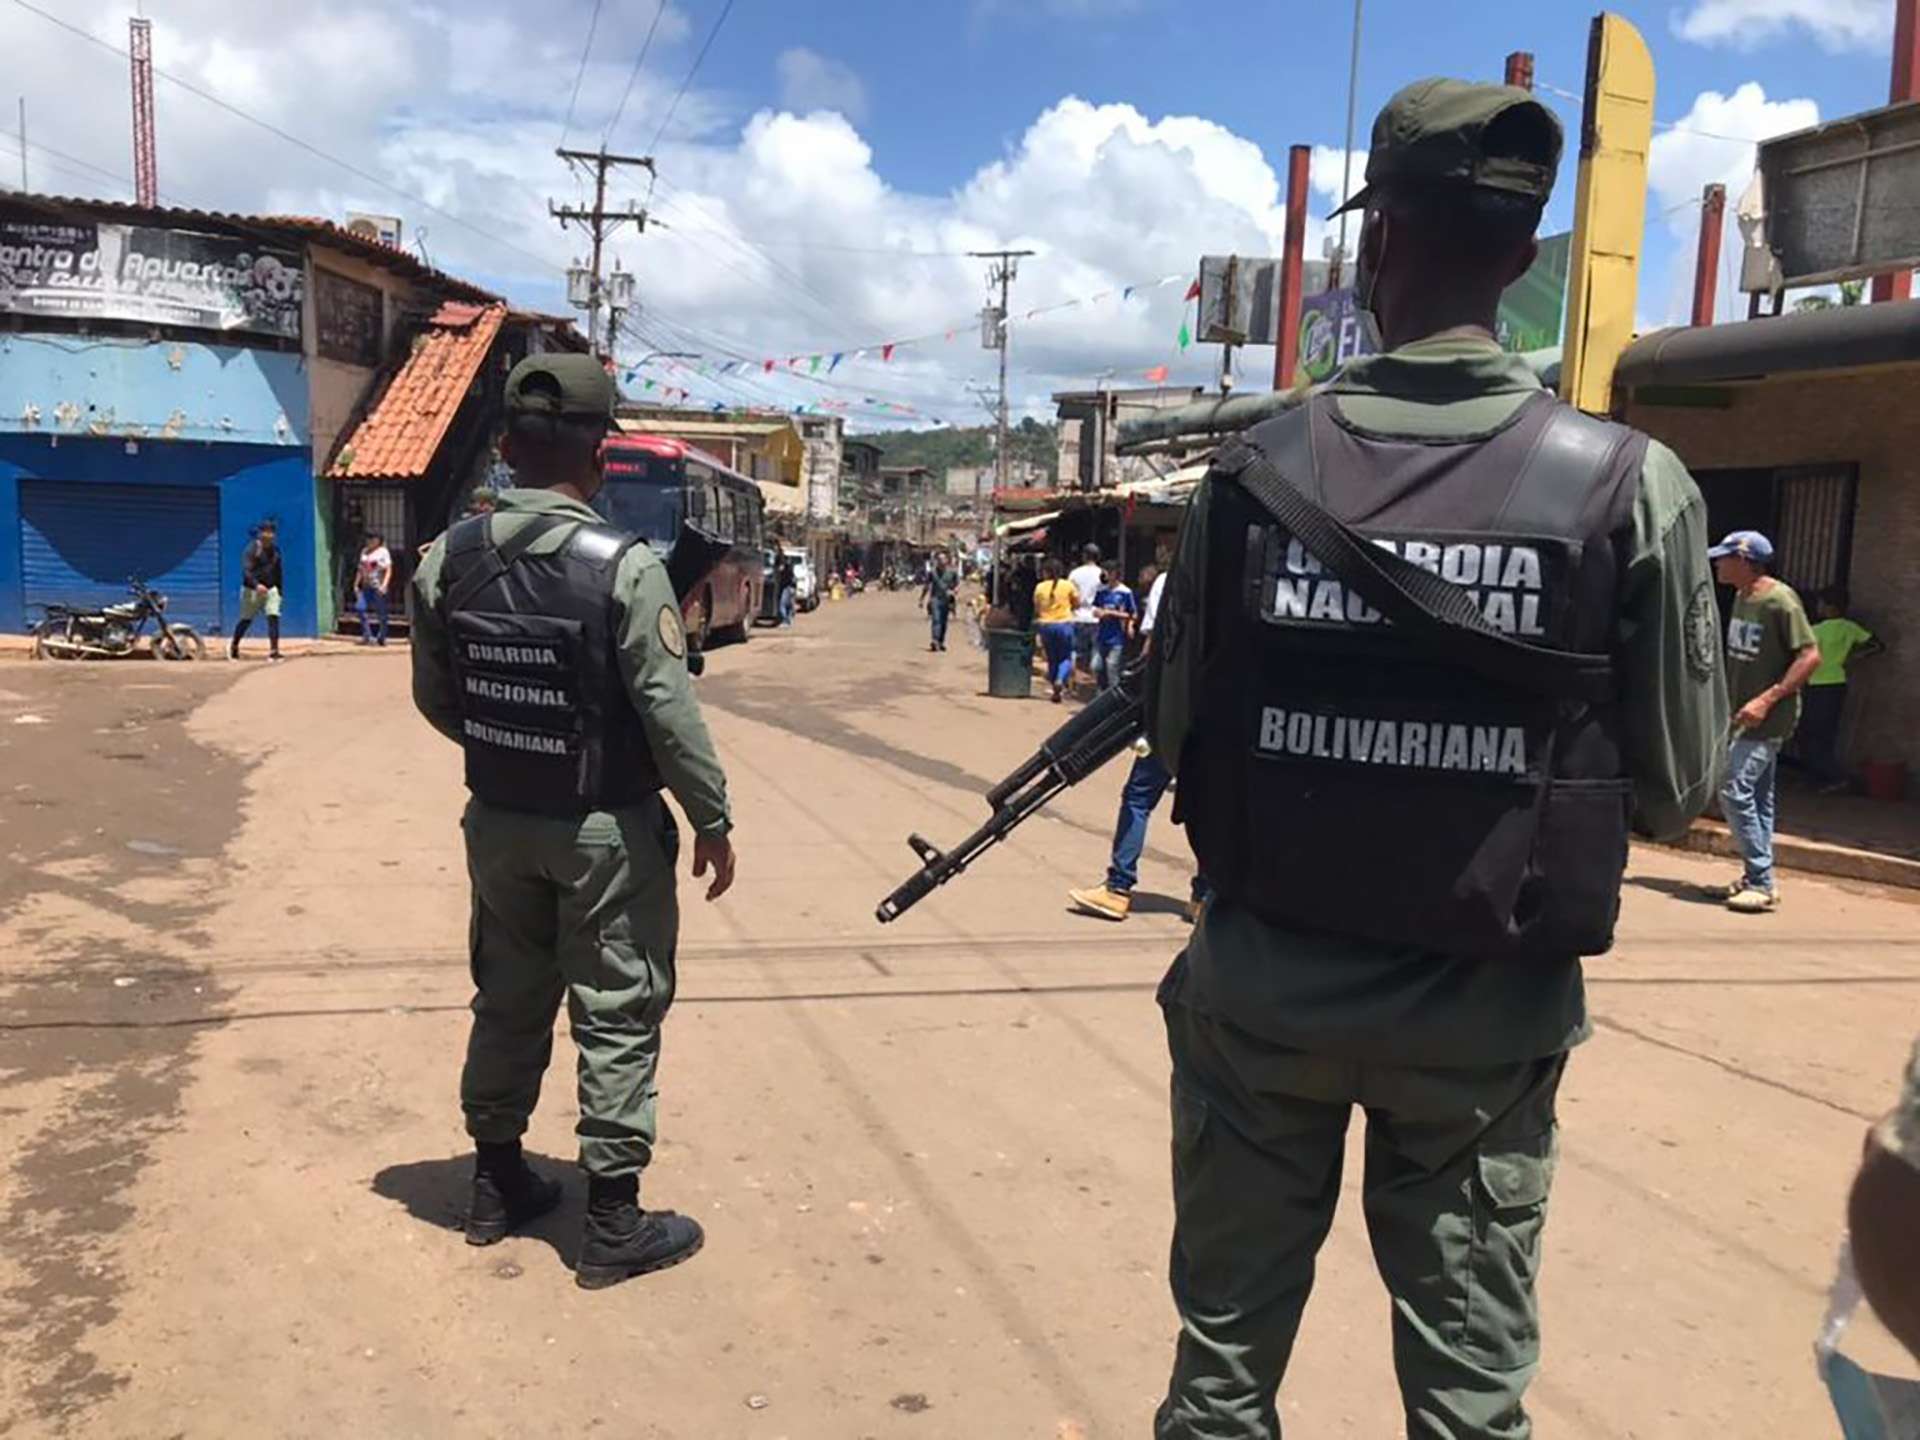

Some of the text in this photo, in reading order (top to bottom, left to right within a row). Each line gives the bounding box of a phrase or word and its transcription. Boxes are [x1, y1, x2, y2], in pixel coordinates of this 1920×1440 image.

[467, 643, 557, 664] GUARDIA
[466, 677, 569, 706] NACIONAL
[464, 719, 567, 755] BOLIVARIANA
[1259, 706, 1527, 774] BOLIVARIANA
